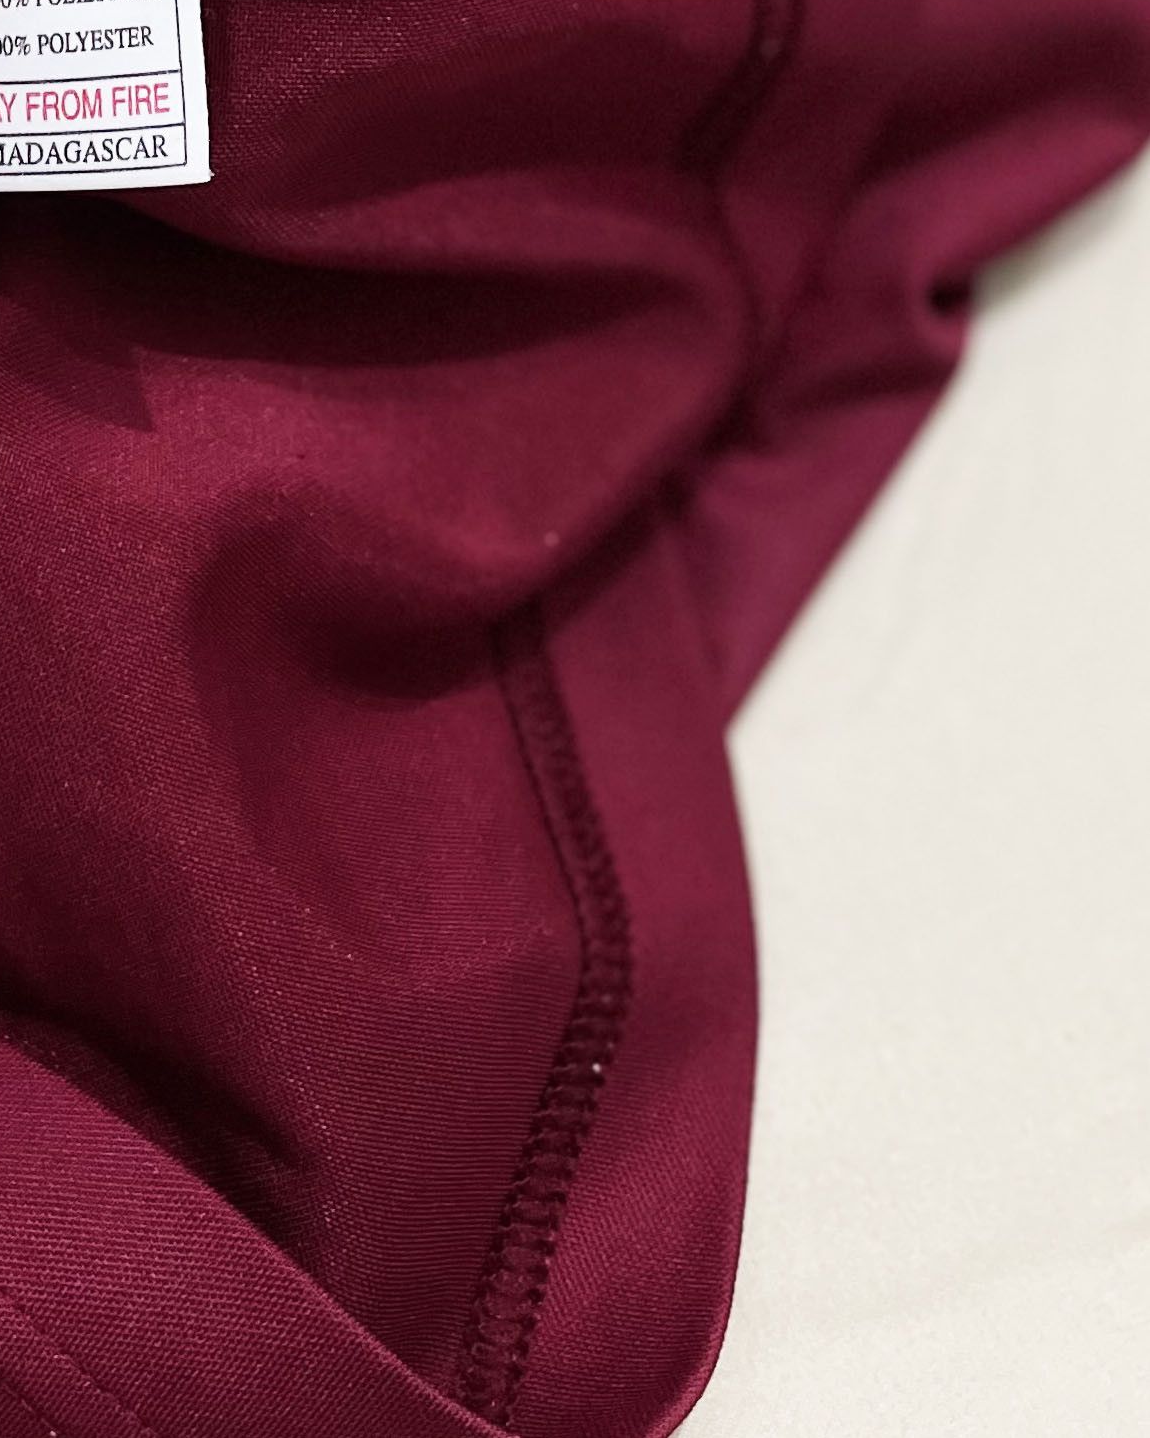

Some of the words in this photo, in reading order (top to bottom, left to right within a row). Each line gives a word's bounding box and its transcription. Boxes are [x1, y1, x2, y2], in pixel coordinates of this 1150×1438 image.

[37, 26, 154, 56] POLYESTER
[25, 87, 103, 122] FROM
[111, 82, 171, 117] FIRE
